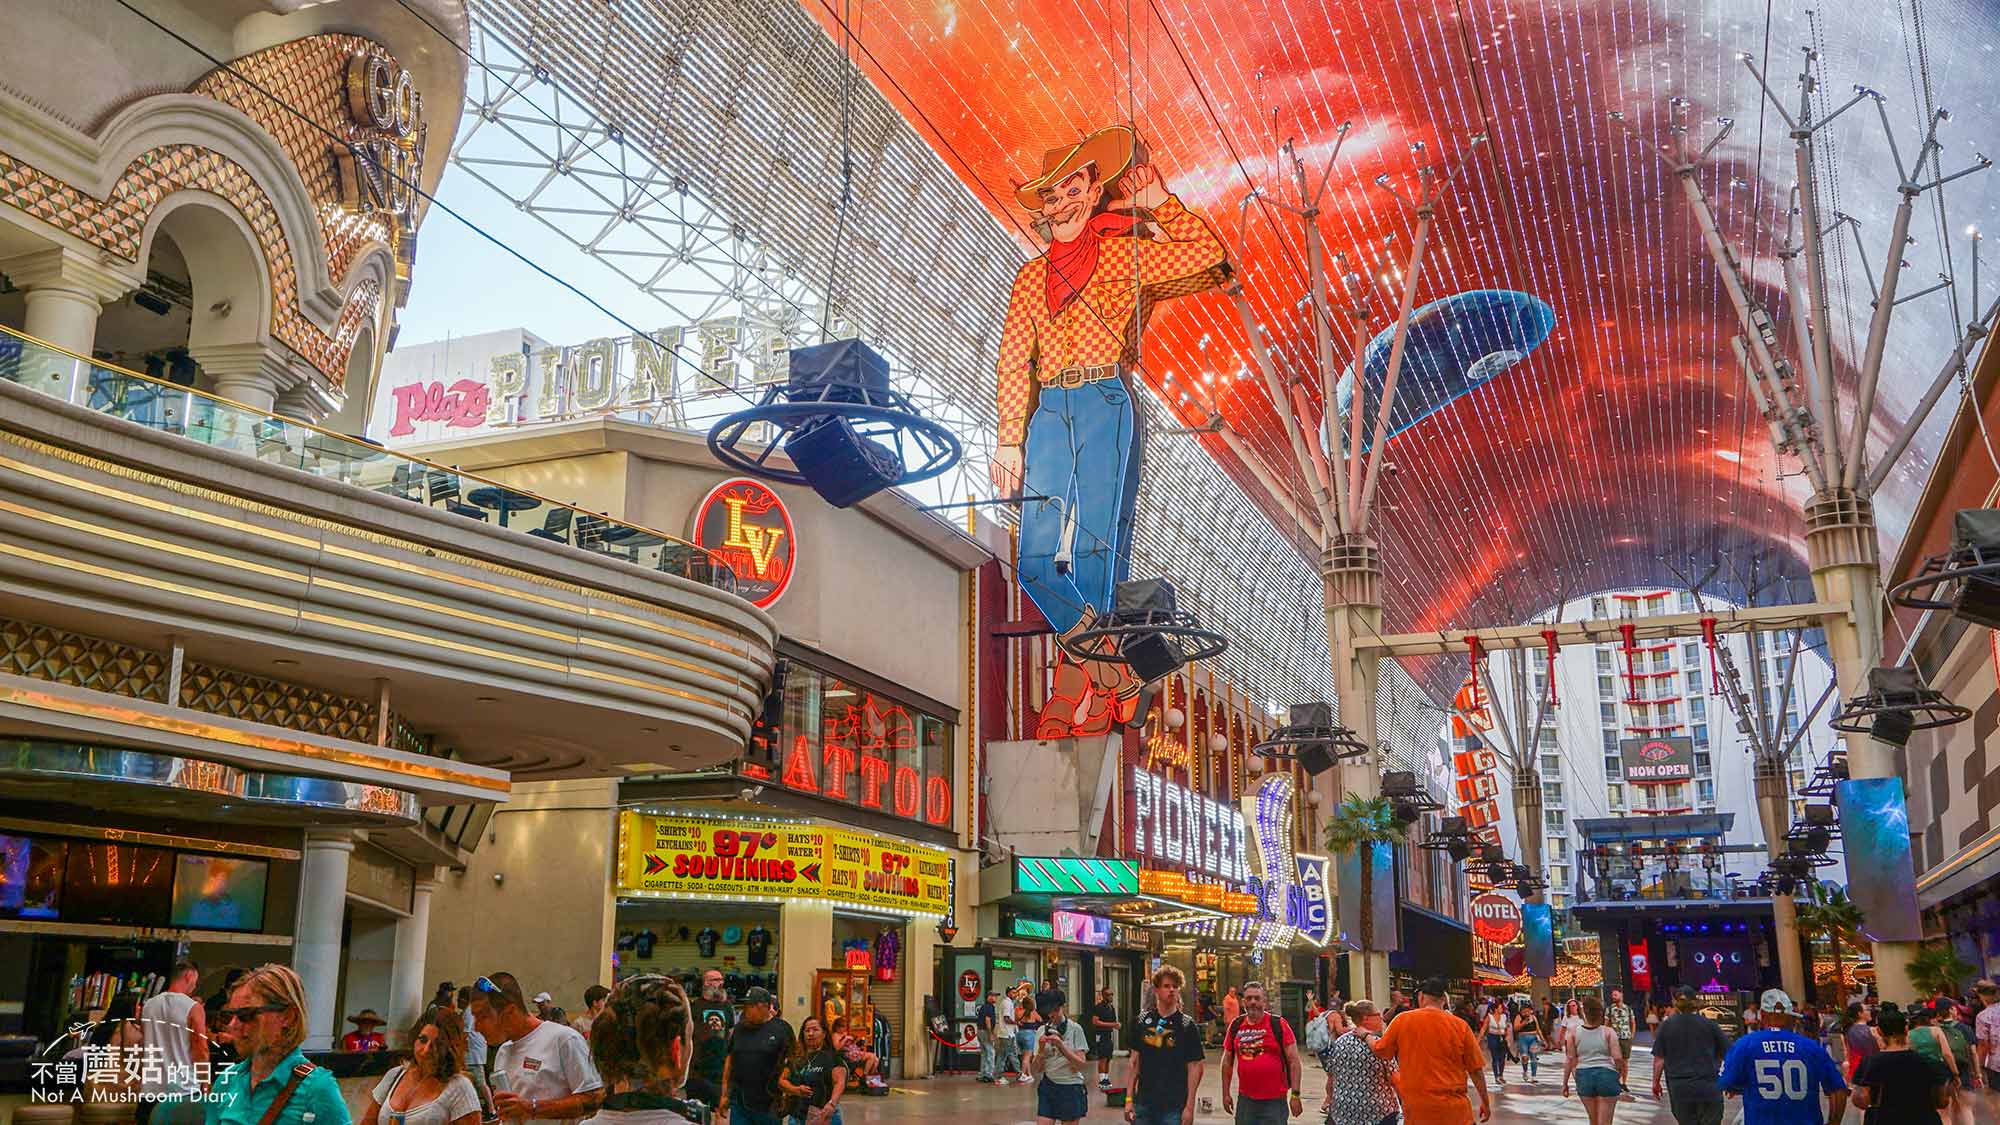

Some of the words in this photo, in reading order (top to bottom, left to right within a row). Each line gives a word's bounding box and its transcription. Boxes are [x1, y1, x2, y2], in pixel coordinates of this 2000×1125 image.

[1629, 766, 1656, 777] NOW
[1657, 764, 1690, 776] OPEN
[1135, 767, 1249, 884] PIONEER
[688, 827, 701, 839] $10
[787, 834, 810, 844] HATS
[811, 835, 823, 846] $10
[787, 847, 814, 857] WATER
[672, 854, 798, 882] SOUVENIRS
[832, 869, 848, 886] HATS
[644, 880, 683, 889] CIGARETTES
[687, 882, 704, 890] SODA
[707, 883, 743, 891] CLOSEOUTS
[1302, 862, 1326, 923] ABC
[1474, 904, 1518, 919] HOTEL
[1762, 1041, 1795, 1053] BETTS
[1755, 1059, 1808, 1100] 50
